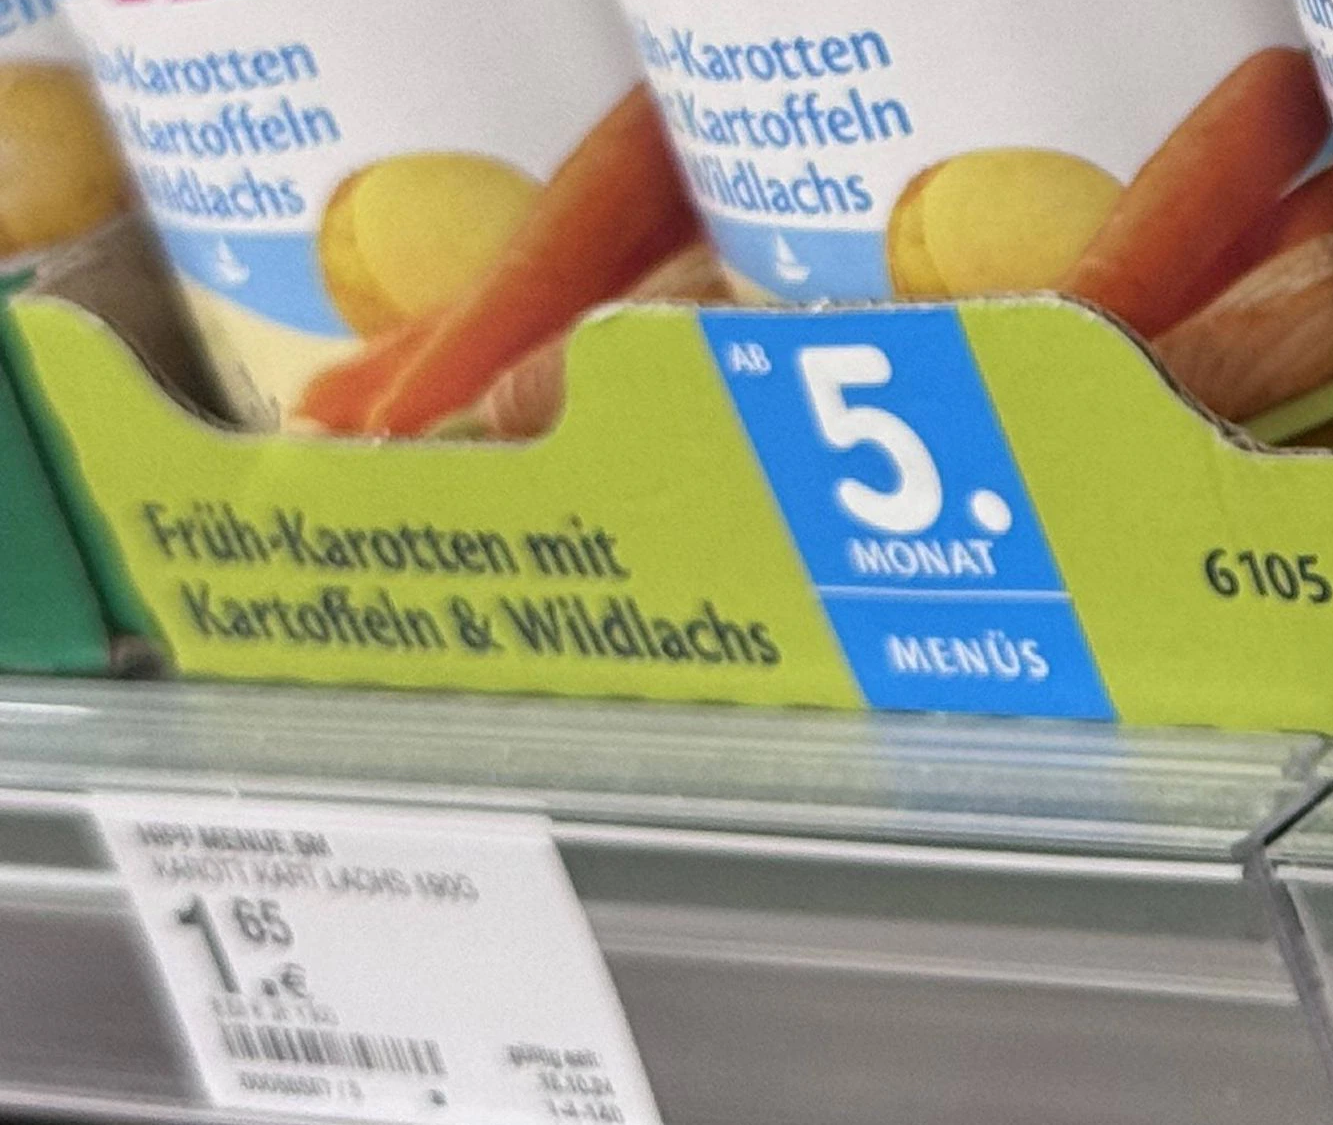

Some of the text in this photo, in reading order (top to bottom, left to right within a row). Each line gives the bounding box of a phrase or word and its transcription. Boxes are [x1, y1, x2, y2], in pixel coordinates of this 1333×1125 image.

[677, 86, 914, 148] Kartoffeln
[729, 342, 772, 376] AB
[798, 342, 1014, 535] 5.
[141, 500, 632, 581] Früh-Karotten mit
[847, 537, 998, 578] MONAT
[179, 578, 783, 665] Kartoffeln & Wildlachs
[885, 629, 1051, 680] MENÜS
[231, 895, 297, 948] 65
